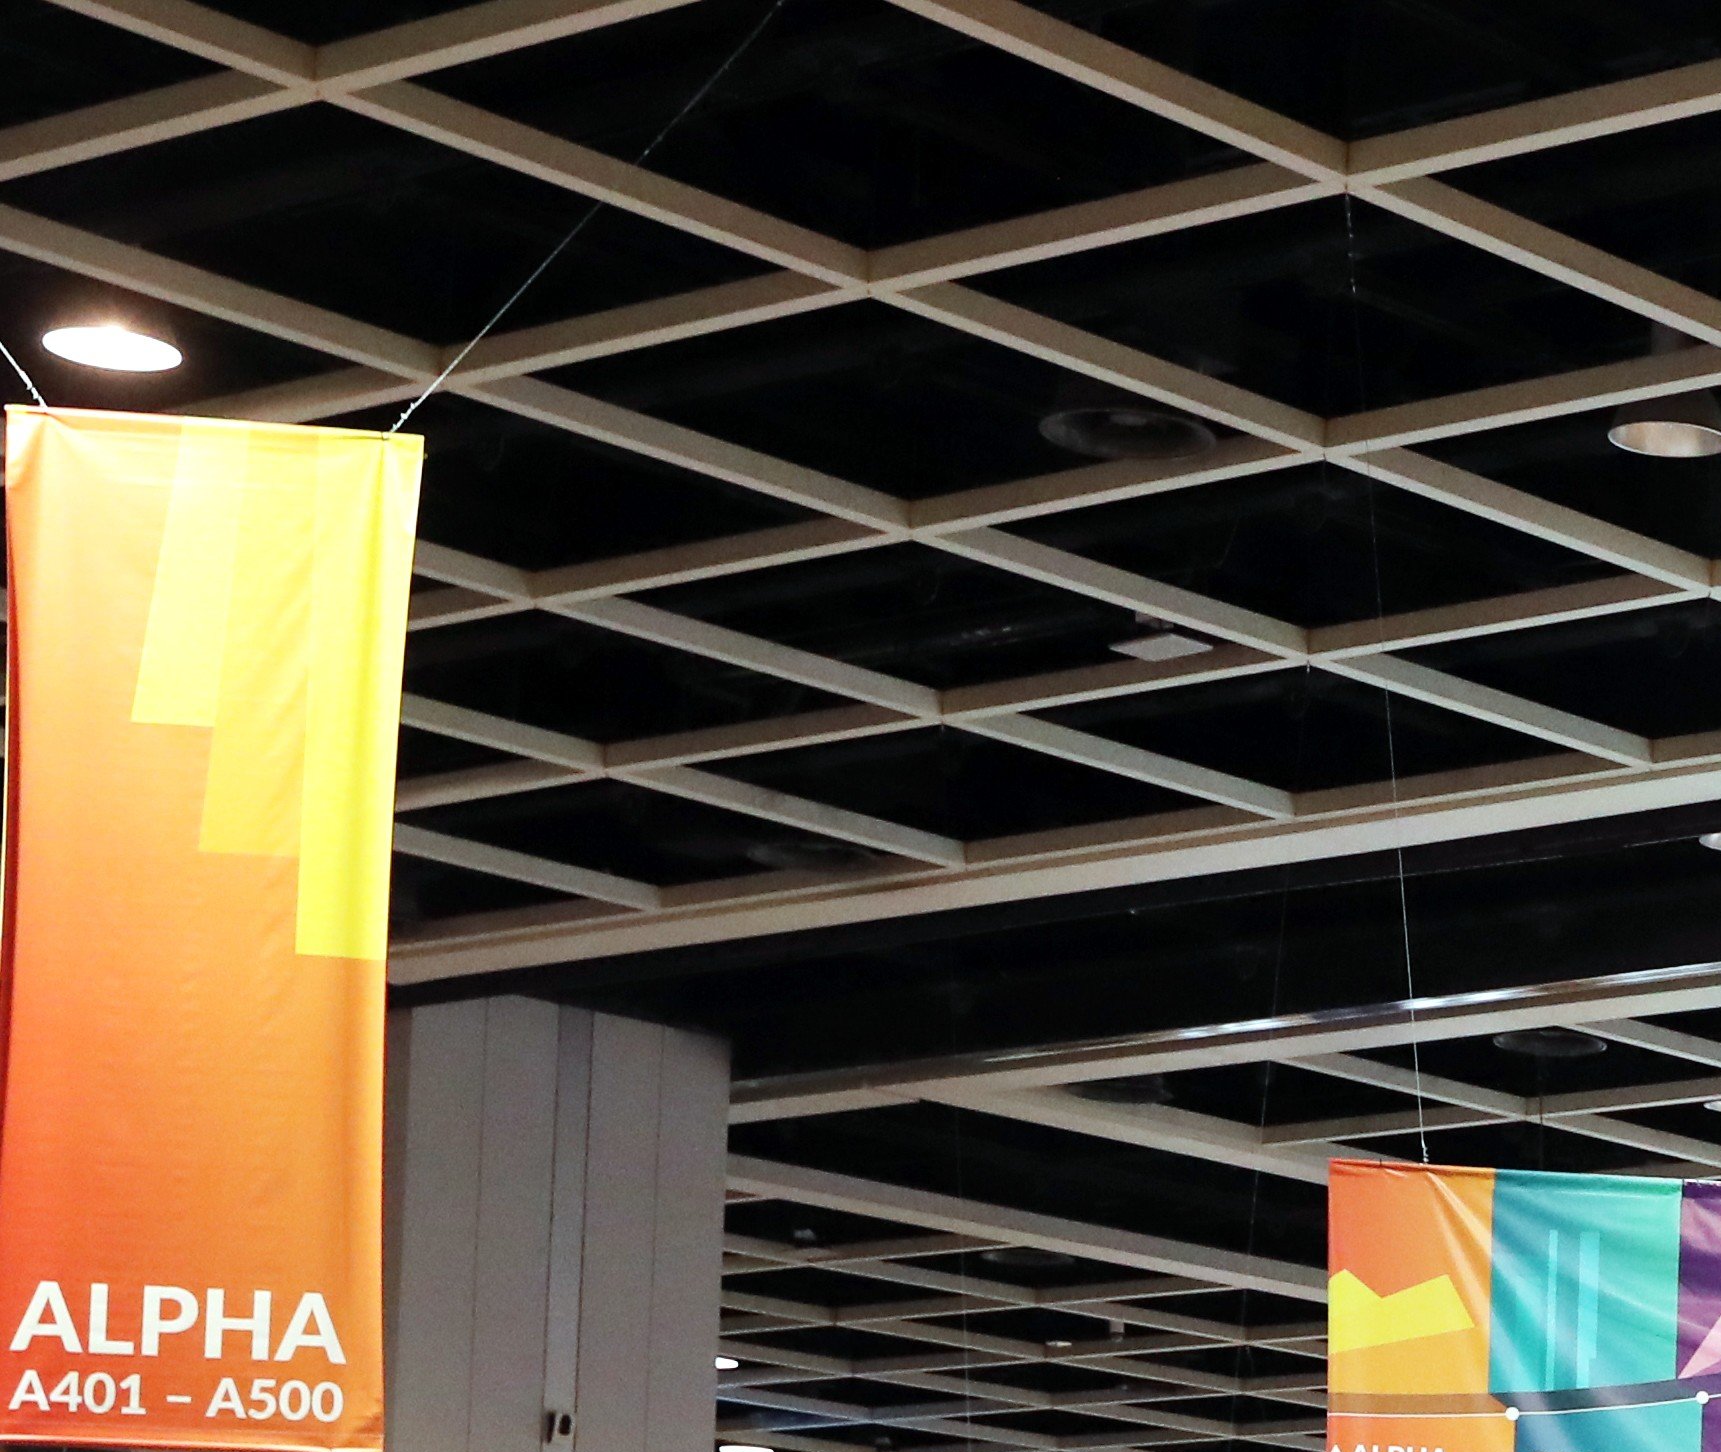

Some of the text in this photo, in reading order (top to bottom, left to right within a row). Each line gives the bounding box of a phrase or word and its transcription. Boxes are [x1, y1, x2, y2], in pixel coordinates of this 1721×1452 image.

[9, 1280, 346, 1364] ALPHA
[8, 1369, 146, 1414] A401
[205, 1377, 344, 1422] A500
